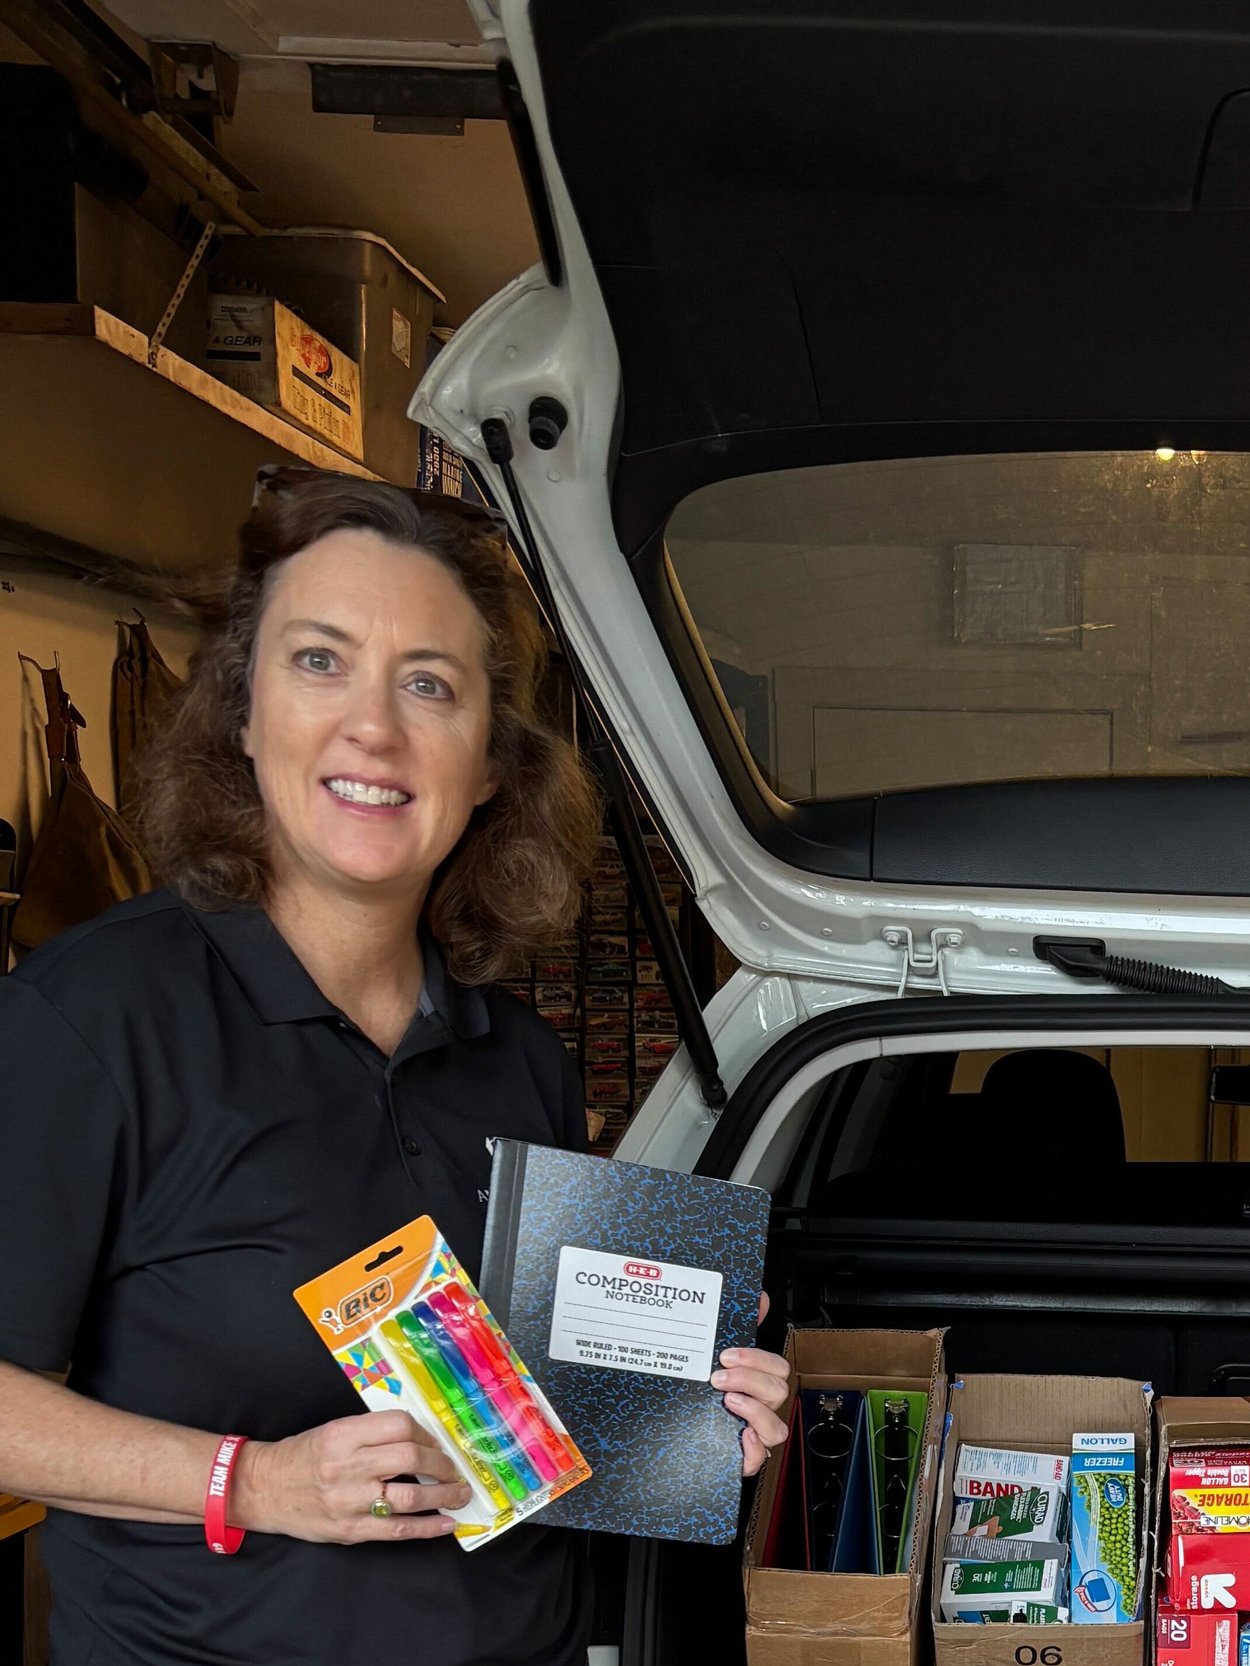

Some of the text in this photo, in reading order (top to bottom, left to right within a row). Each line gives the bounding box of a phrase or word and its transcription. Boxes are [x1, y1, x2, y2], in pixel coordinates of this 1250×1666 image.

[223, 335, 263, 347] GEAR
[575, 1271, 707, 1305] COMPOSITION
[605, 1290, 674, 1310] NOTEBOOK
[630, 1347, 652, 1358] SHEETS
[669, 1353, 690, 1364] PAGES
[1081, 1437, 1127, 1446] GALLON
[217, 1440, 238, 1466] MIKE
[1084, 1457, 1124, 1466] FREEZER
[209, 1465, 229, 1496] TEAM
[1201, 1478, 1229, 1486] GALLON
[1233, 1474, 1248, 1484] 30
[1034, 1494, 1048, 1526] CURAD
[1190, 1575, 1198, 1610] storage
[1170, 1620, 1188, 1642] 20
